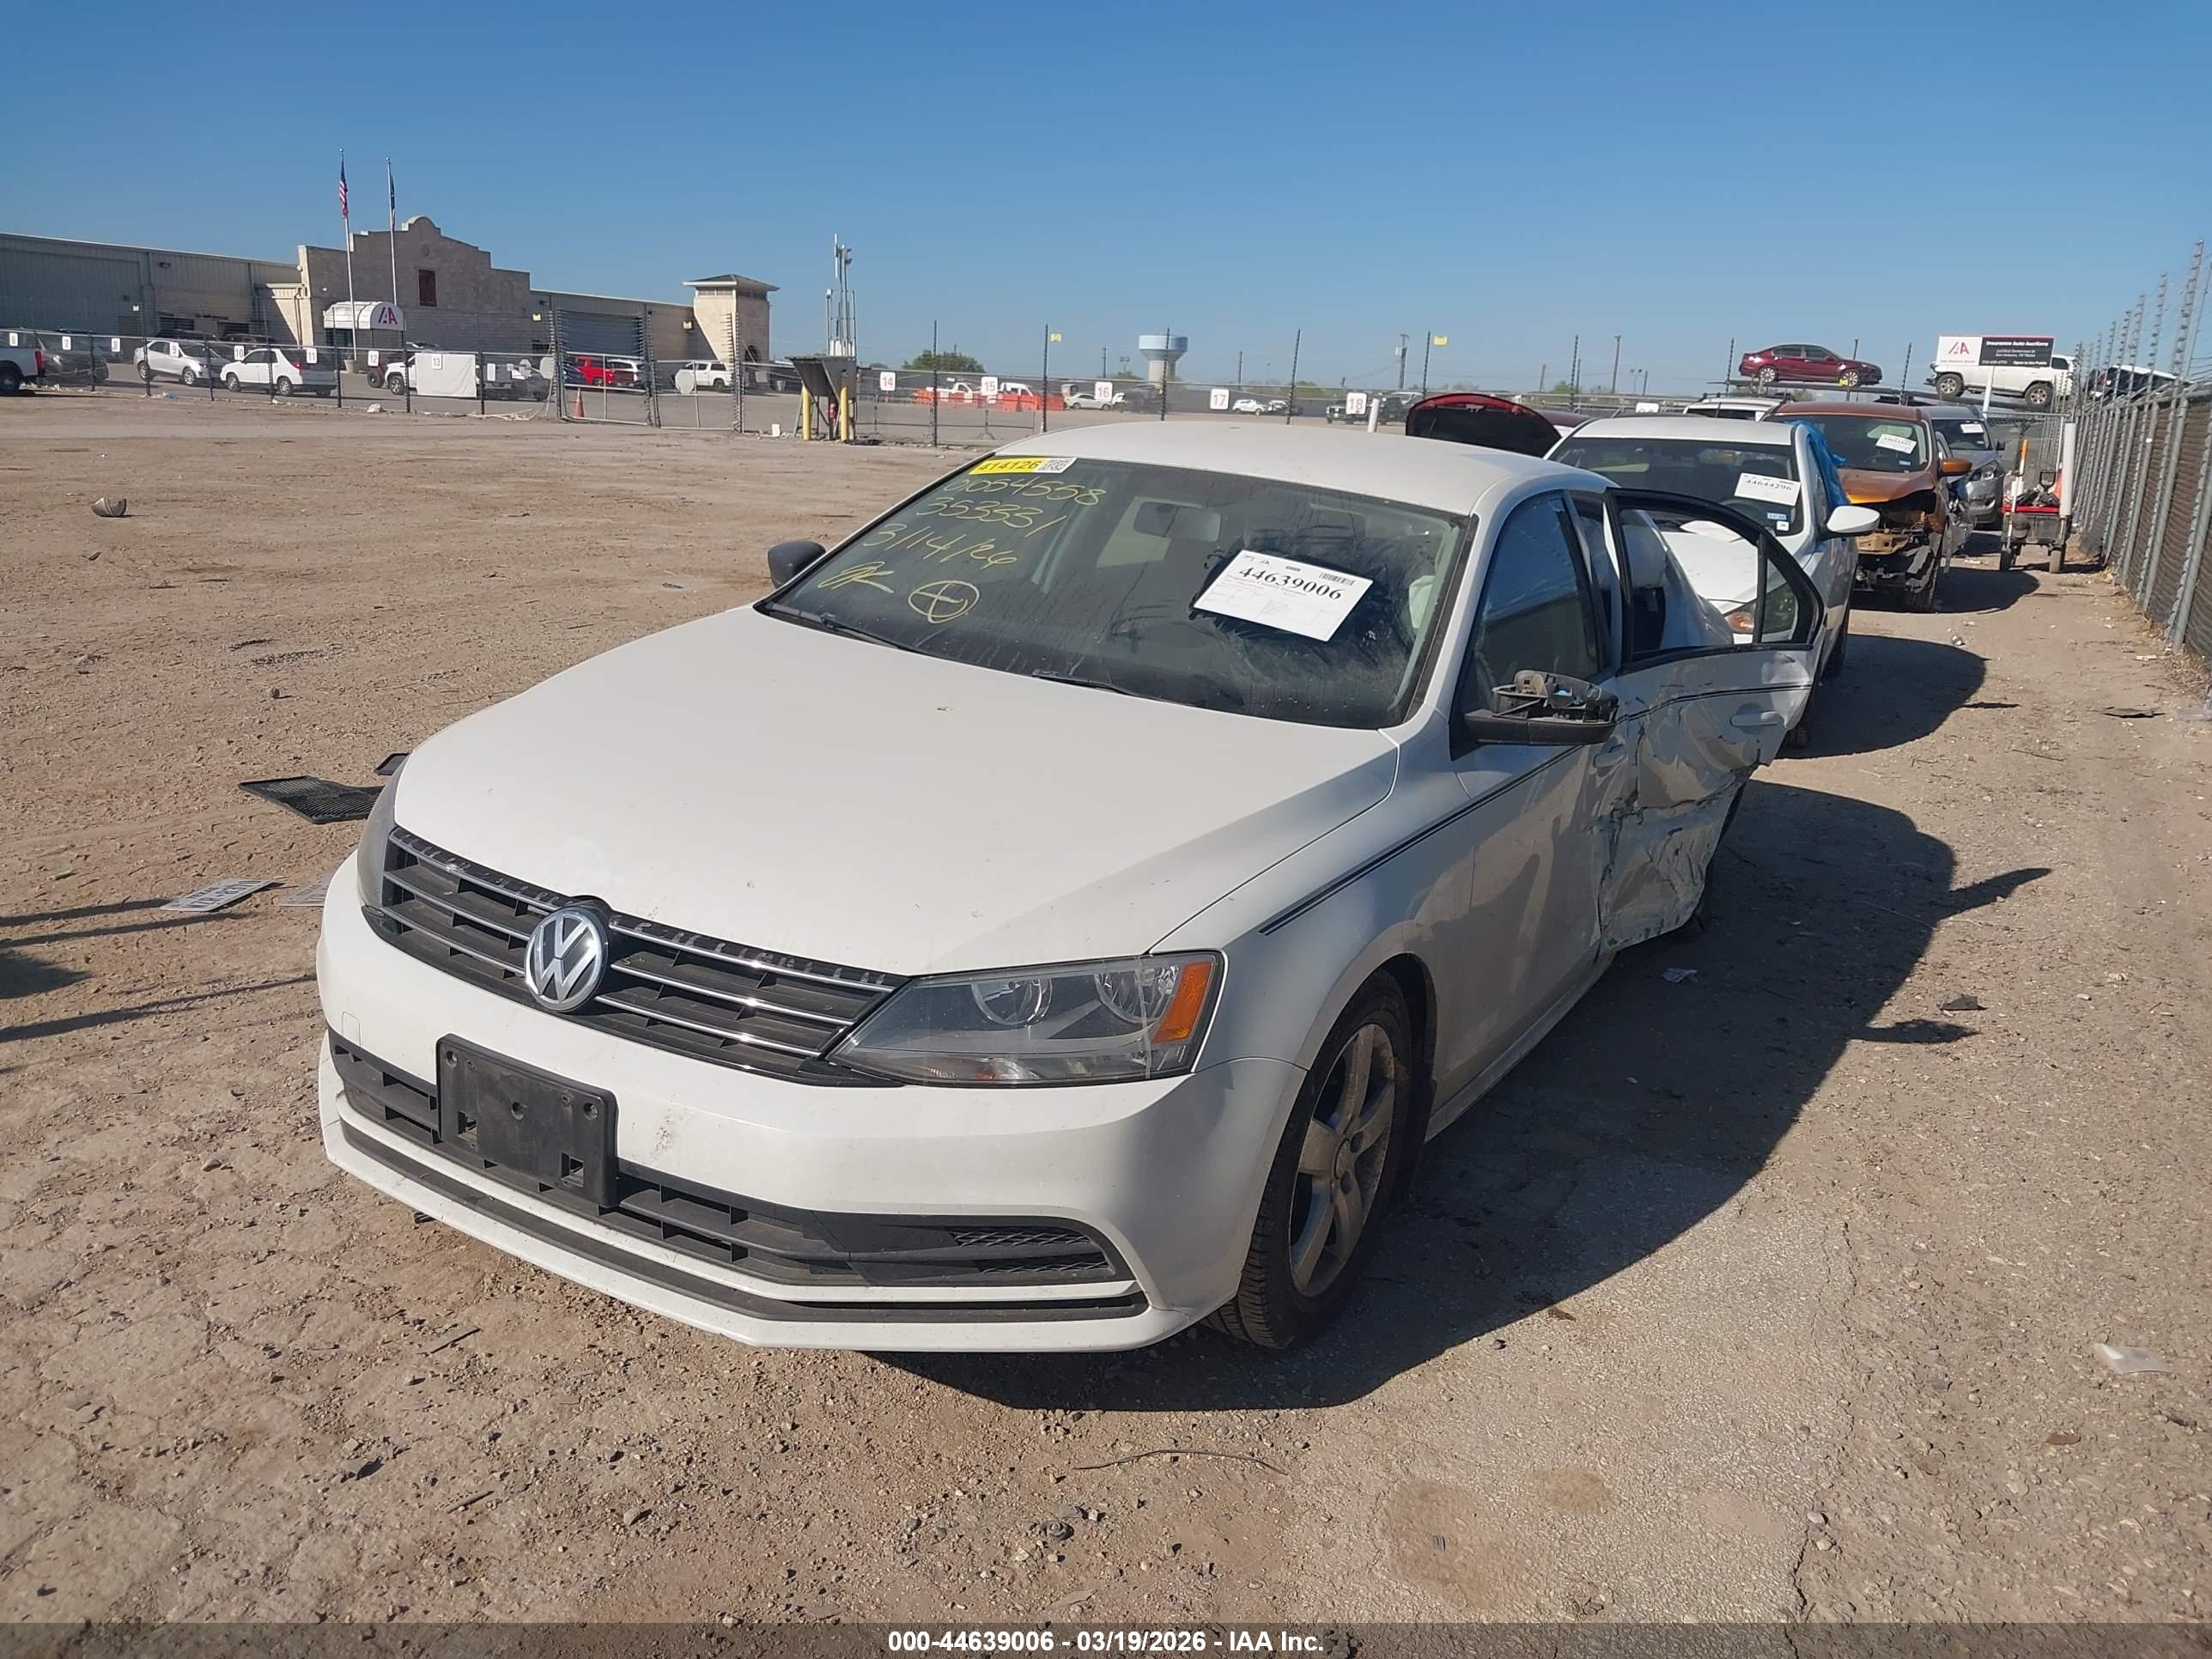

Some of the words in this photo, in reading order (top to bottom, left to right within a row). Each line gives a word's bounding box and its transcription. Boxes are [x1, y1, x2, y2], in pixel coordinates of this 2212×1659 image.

[369, 355, 378, 363] 12
[883, 377, 893, 387] 14
[984, 381, 996, 392] 15
[1097, 386, 1109, 398] 16
[1213, 394, 1227, 406] 17
[1349, 398, 1364, 410] 18
[978, 460, 1042, 471] 414126
[1239, 566, 1346, 600] 44639006
